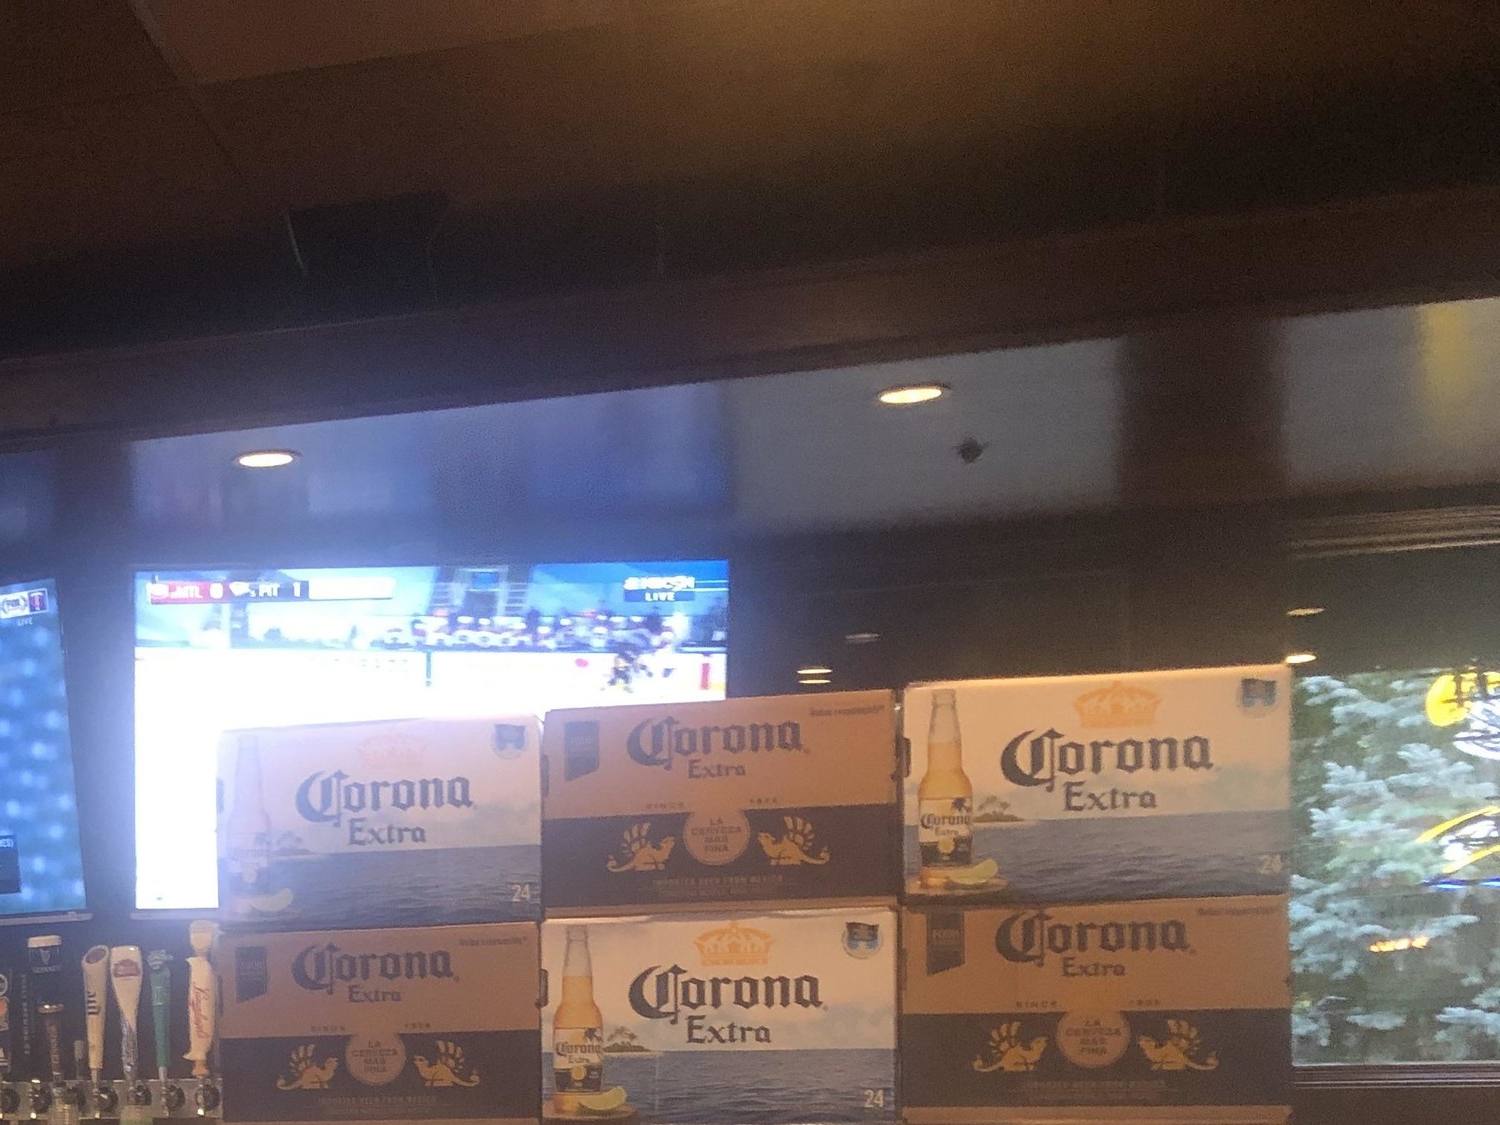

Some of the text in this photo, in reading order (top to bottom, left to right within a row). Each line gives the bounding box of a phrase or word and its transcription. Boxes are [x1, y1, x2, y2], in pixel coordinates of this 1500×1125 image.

[259, 584, 280, 597] PIT
[645, 591, 676, 601] LIVE
[626, 715, 804, 771] Corona
[688, 759, 746, 779] Extra
[1001, 728, 1214, 792] Corona
[294, 769, 474, 827] Corona
[1063, 781, 1157, 811] Extra
[920, 813, 972, 829] Corona
[347, 818, 427, 846] Extra
[1259, 855, 1283, 875] 24
[512, 884, 531, 902] 24
[995, 910, 1189, 967] Corona
[291, 943, 454, 995] Corona
[1061, 957, 1127, 977] Extra
[348, 985, 401, 1003] Extra
[628, 964, 823, 1024] Corona
[685, 1015, 771, 1044] Extra
[556, 1041, 602, 1057] Corona
[864, 1090, 885, 1108] 24
